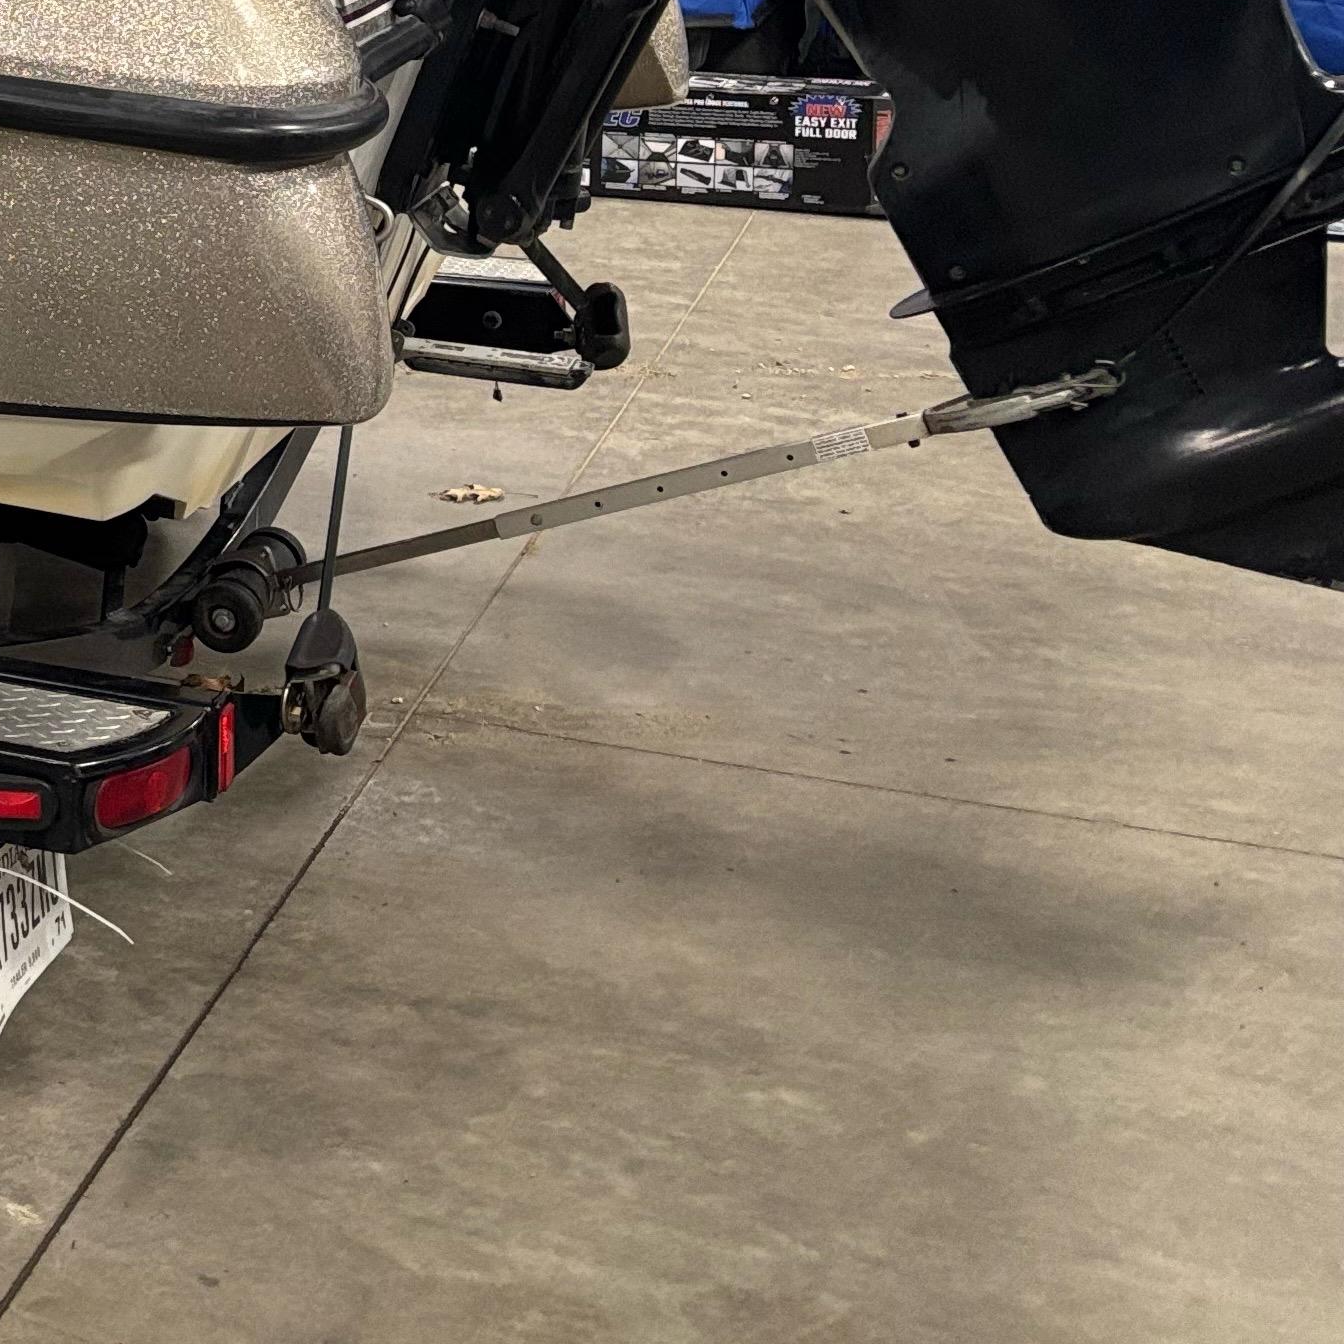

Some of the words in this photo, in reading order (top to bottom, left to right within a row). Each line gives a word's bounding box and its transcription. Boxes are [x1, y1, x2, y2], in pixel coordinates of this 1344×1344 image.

[806, 103, 847, 116] NEW
[794, 116, 828, 127] EASY
[830, 117, 858, 129] EXIT
[794, 128, 823, 138] FULL
[824, 129, 857, 140] DOOR
